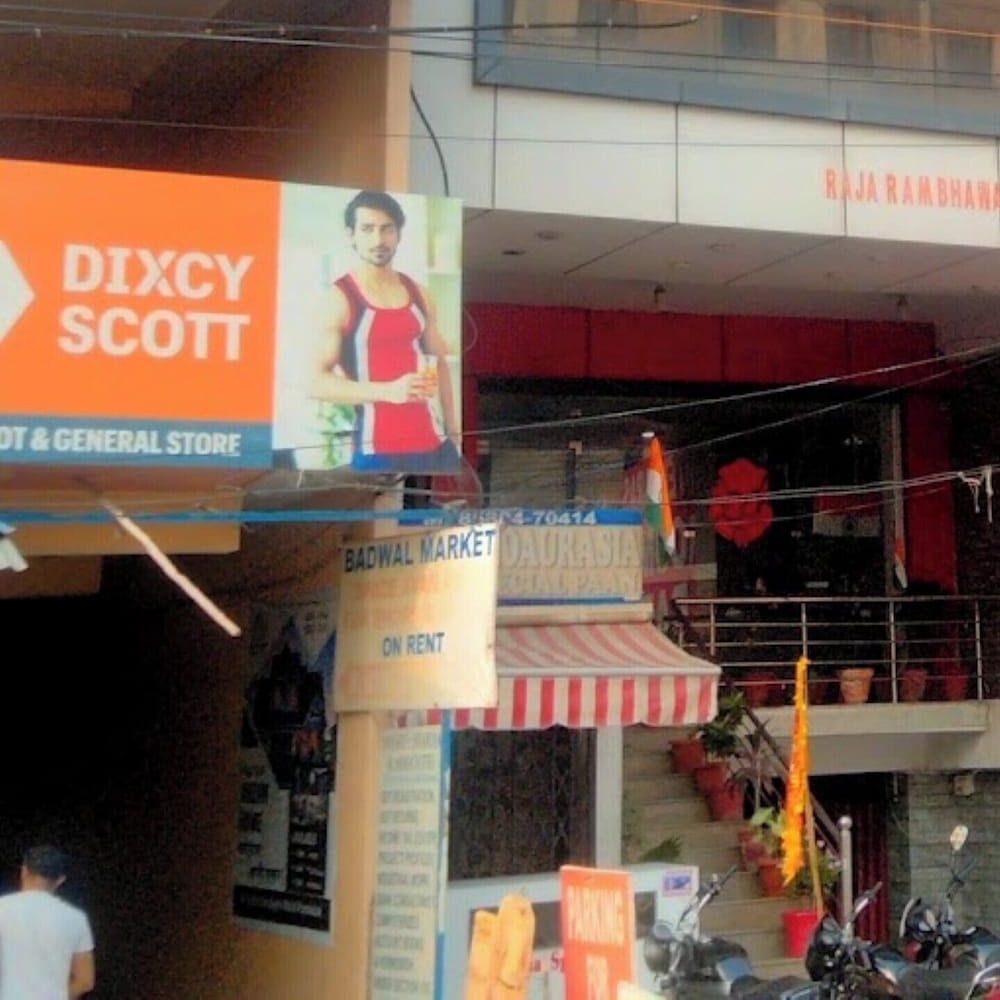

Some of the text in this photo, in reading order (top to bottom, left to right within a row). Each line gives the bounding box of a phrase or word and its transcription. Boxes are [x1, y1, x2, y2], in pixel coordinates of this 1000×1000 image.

[825, 167, 878, 203] RAJA
[885, 173, 933, 206] RAM
[63, 244, 254, 301] DIXCY
[58, 305, 250, 361] SCOTT
[30, 427, 51, 451] &
[53, 428, 162, 455] GENERAL
[167, 430, 242, 457] STORE
[344, 529, 497, 573] BADWAL MARKET
[382, 631, 446, 657] ON RENT
